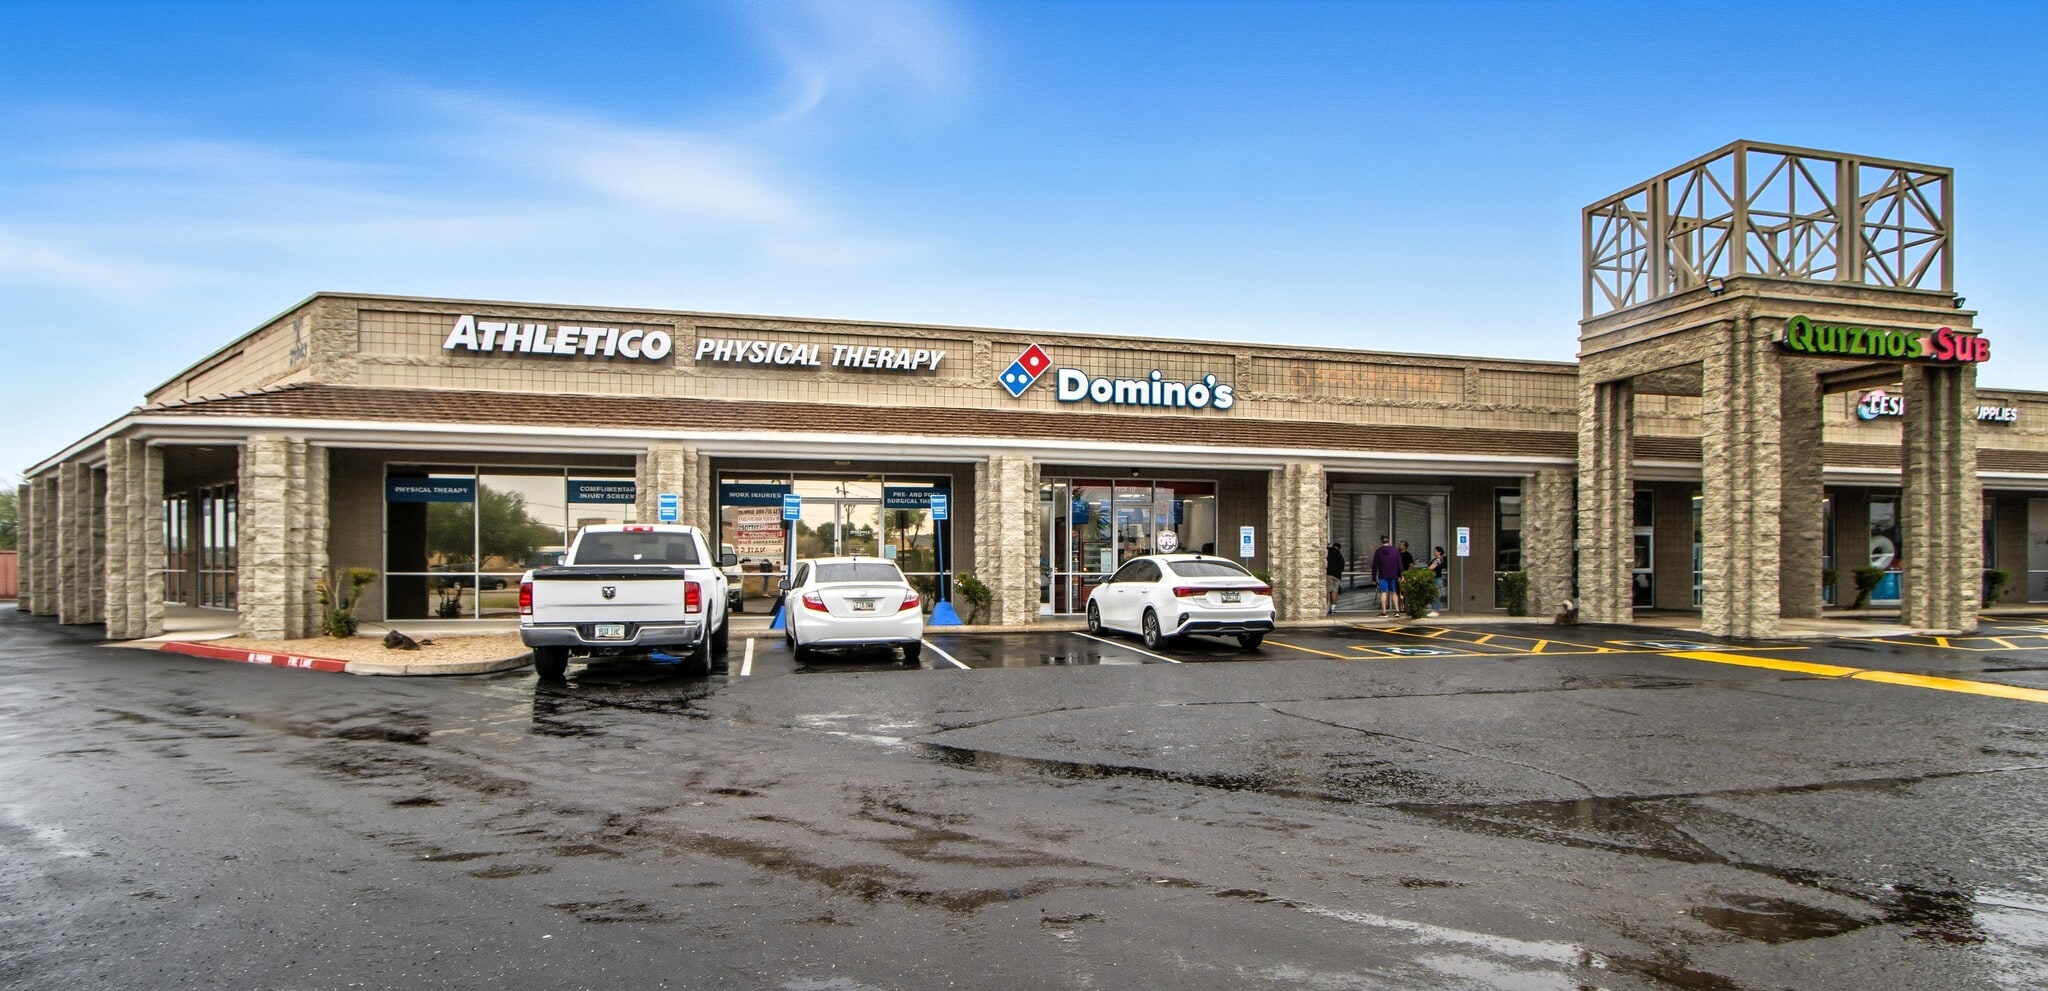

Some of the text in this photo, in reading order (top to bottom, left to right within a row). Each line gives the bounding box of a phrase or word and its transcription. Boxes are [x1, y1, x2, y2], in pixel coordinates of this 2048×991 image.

[443, 315, 672, 360] ATHLETICO
[694, 338, 946, 372] PHYSICAL THERAPY
[1056, 367, 1235, 410] Domino's
[1975, 406, 2018, 421] UPPLIES
